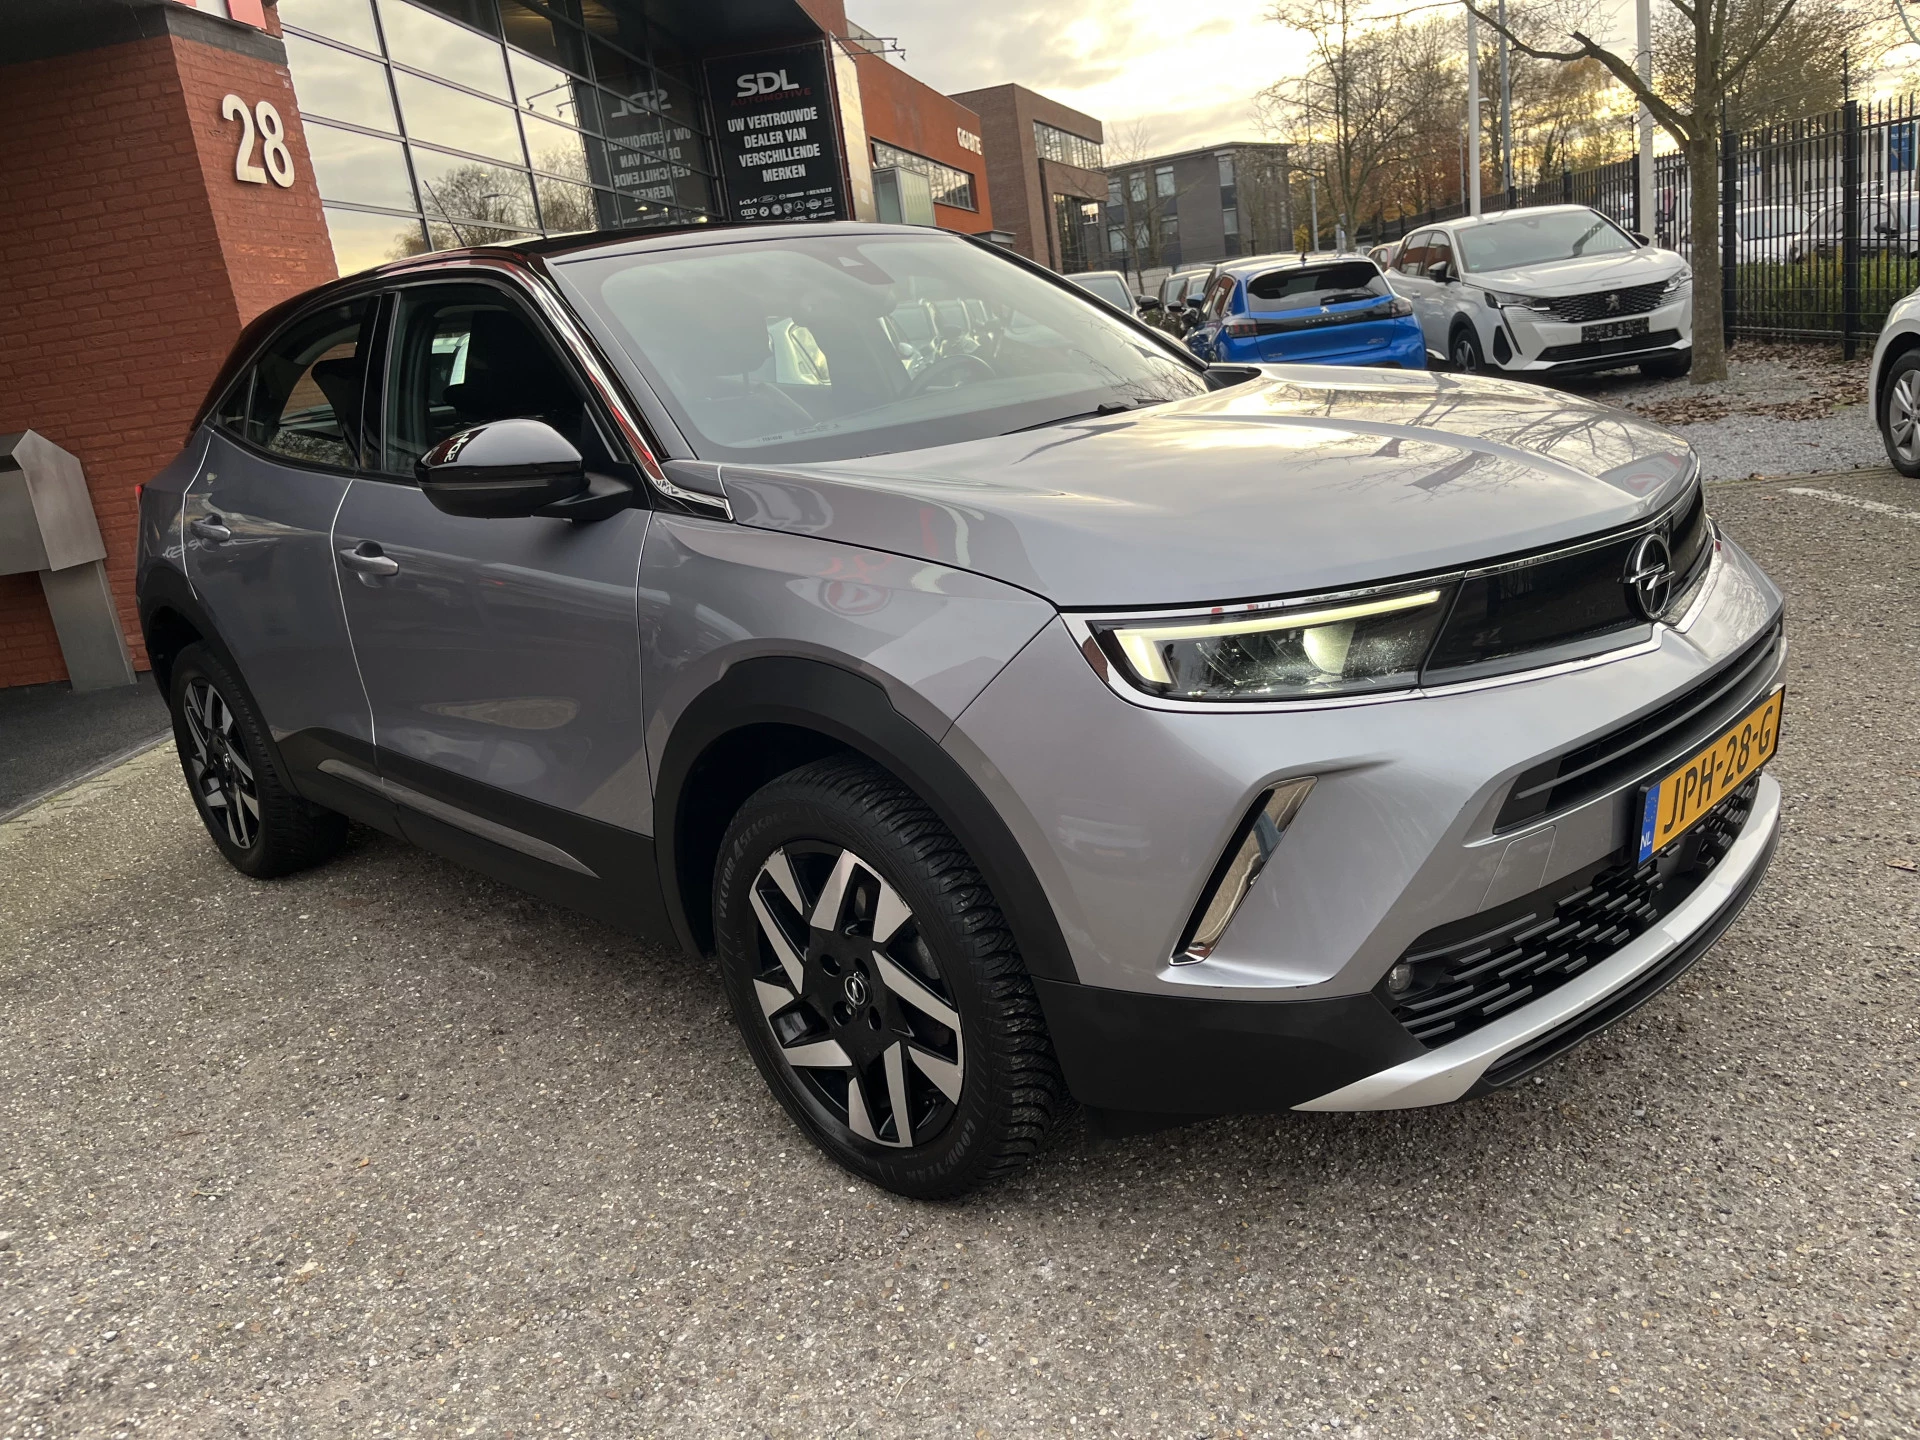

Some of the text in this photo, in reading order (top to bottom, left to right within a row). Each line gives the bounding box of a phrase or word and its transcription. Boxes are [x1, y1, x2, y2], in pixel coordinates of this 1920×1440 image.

[736, 69, 799, 97] SDL
[730, 87, 812, 107] AUTOMOTIVE
[727, 106, 818, 132] UW VERTROUWDE
[222, 94, 295, 188] 28
[744, 127, 808, 148] DEALER VAN
[739, 143, 821, 168] VERSCHILLENDE
[762, 164, 806, 183] MERKEN
[1663, 705, 1773, 835] JPH-28-G
[1640, 832, 1652, 850] NL
